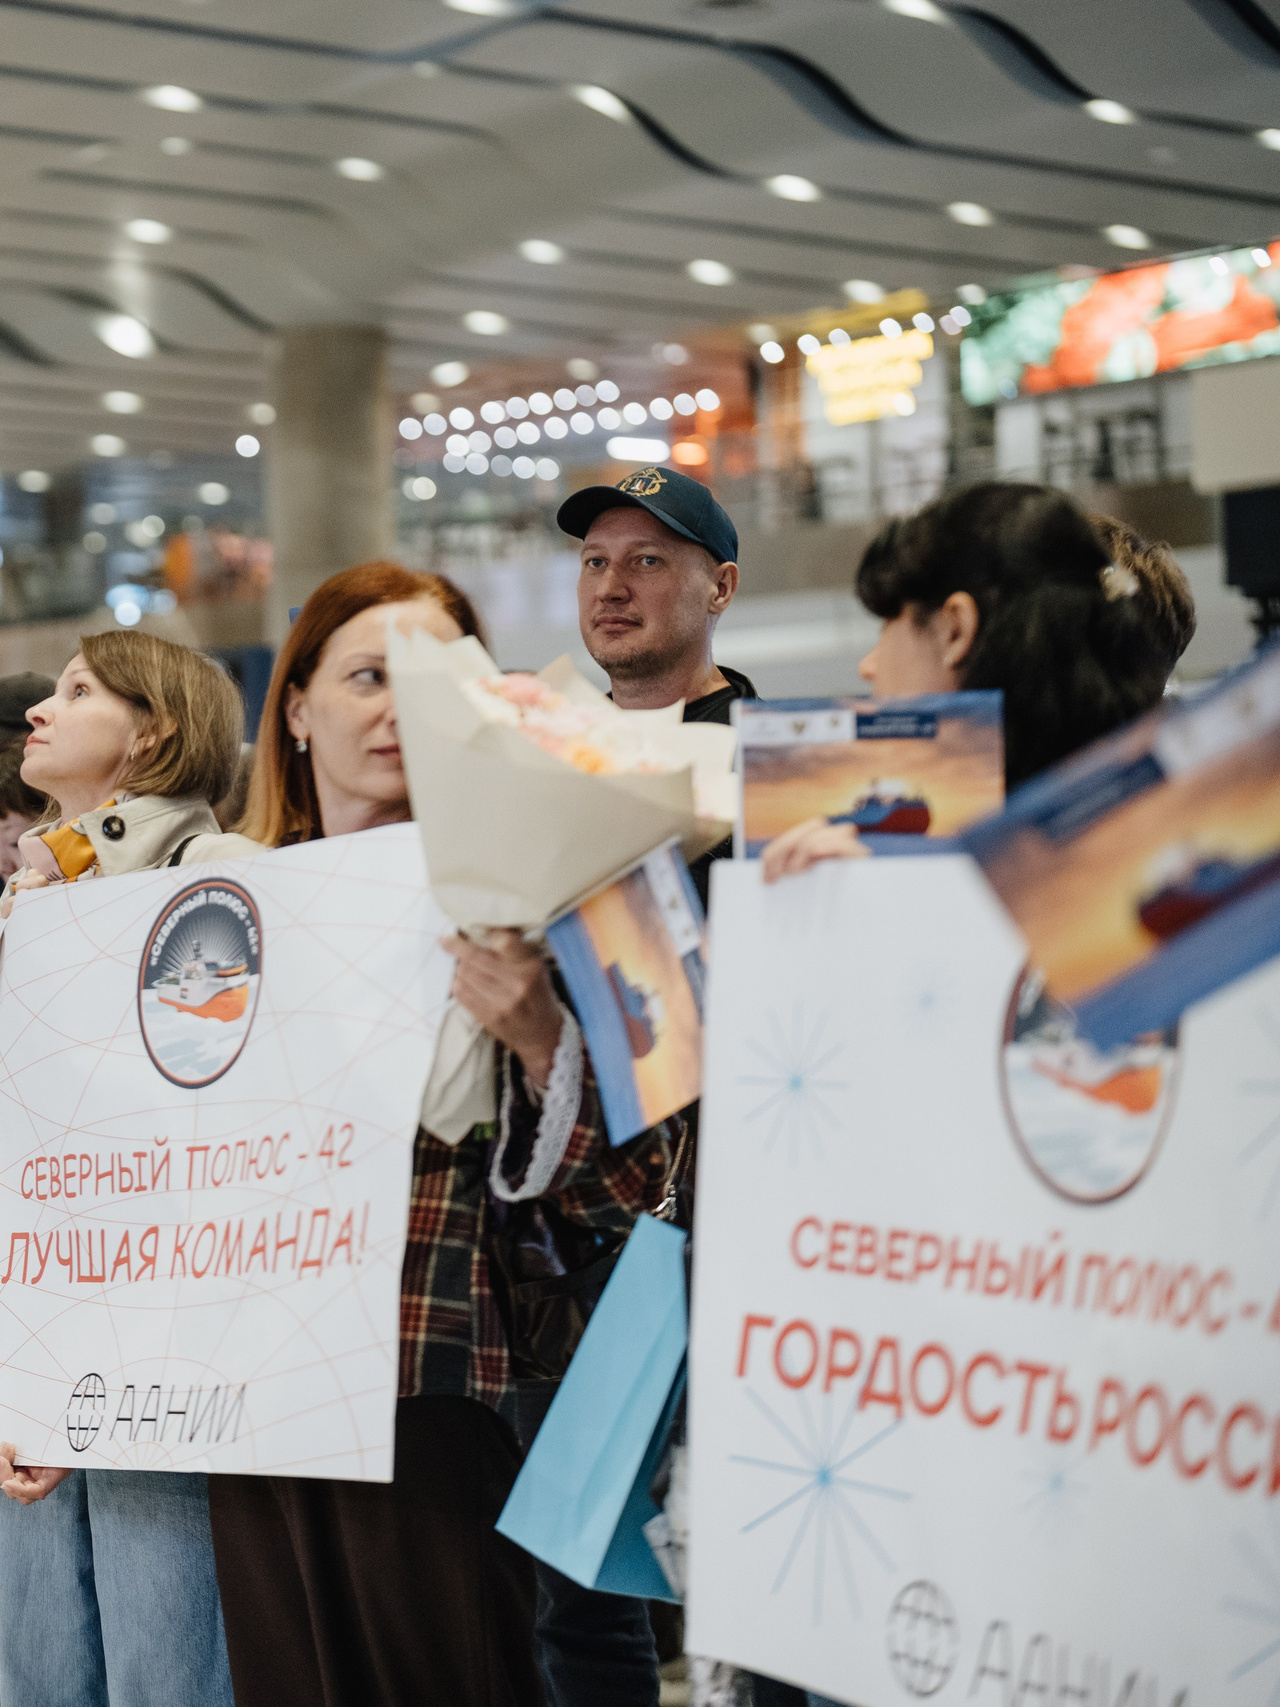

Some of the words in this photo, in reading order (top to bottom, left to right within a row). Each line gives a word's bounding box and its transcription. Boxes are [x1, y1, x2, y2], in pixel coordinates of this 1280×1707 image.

[20, 1136, 170, 1201] СЕВЕРНЫЙ
[186, 1132, 291, 1190] ПОЛЮС
[317, 1122, 355, 1171] 42
[0, 1225, 160, 1285] ЛУЧШАЯ
[170, 1201, 371, 1280] КОМАНДА!
[790, 1216, 1067, 1302] СЕВЕРНЫЙ
[1074, 1252, 1234, 1337] ПОЛЮС
[109, 1383, 247, 1443] ААНИИ
[734, 1314, 1081, 1443] ГОРДОСТЬ
[1088, 1376, 1280, 1499] РОСС
